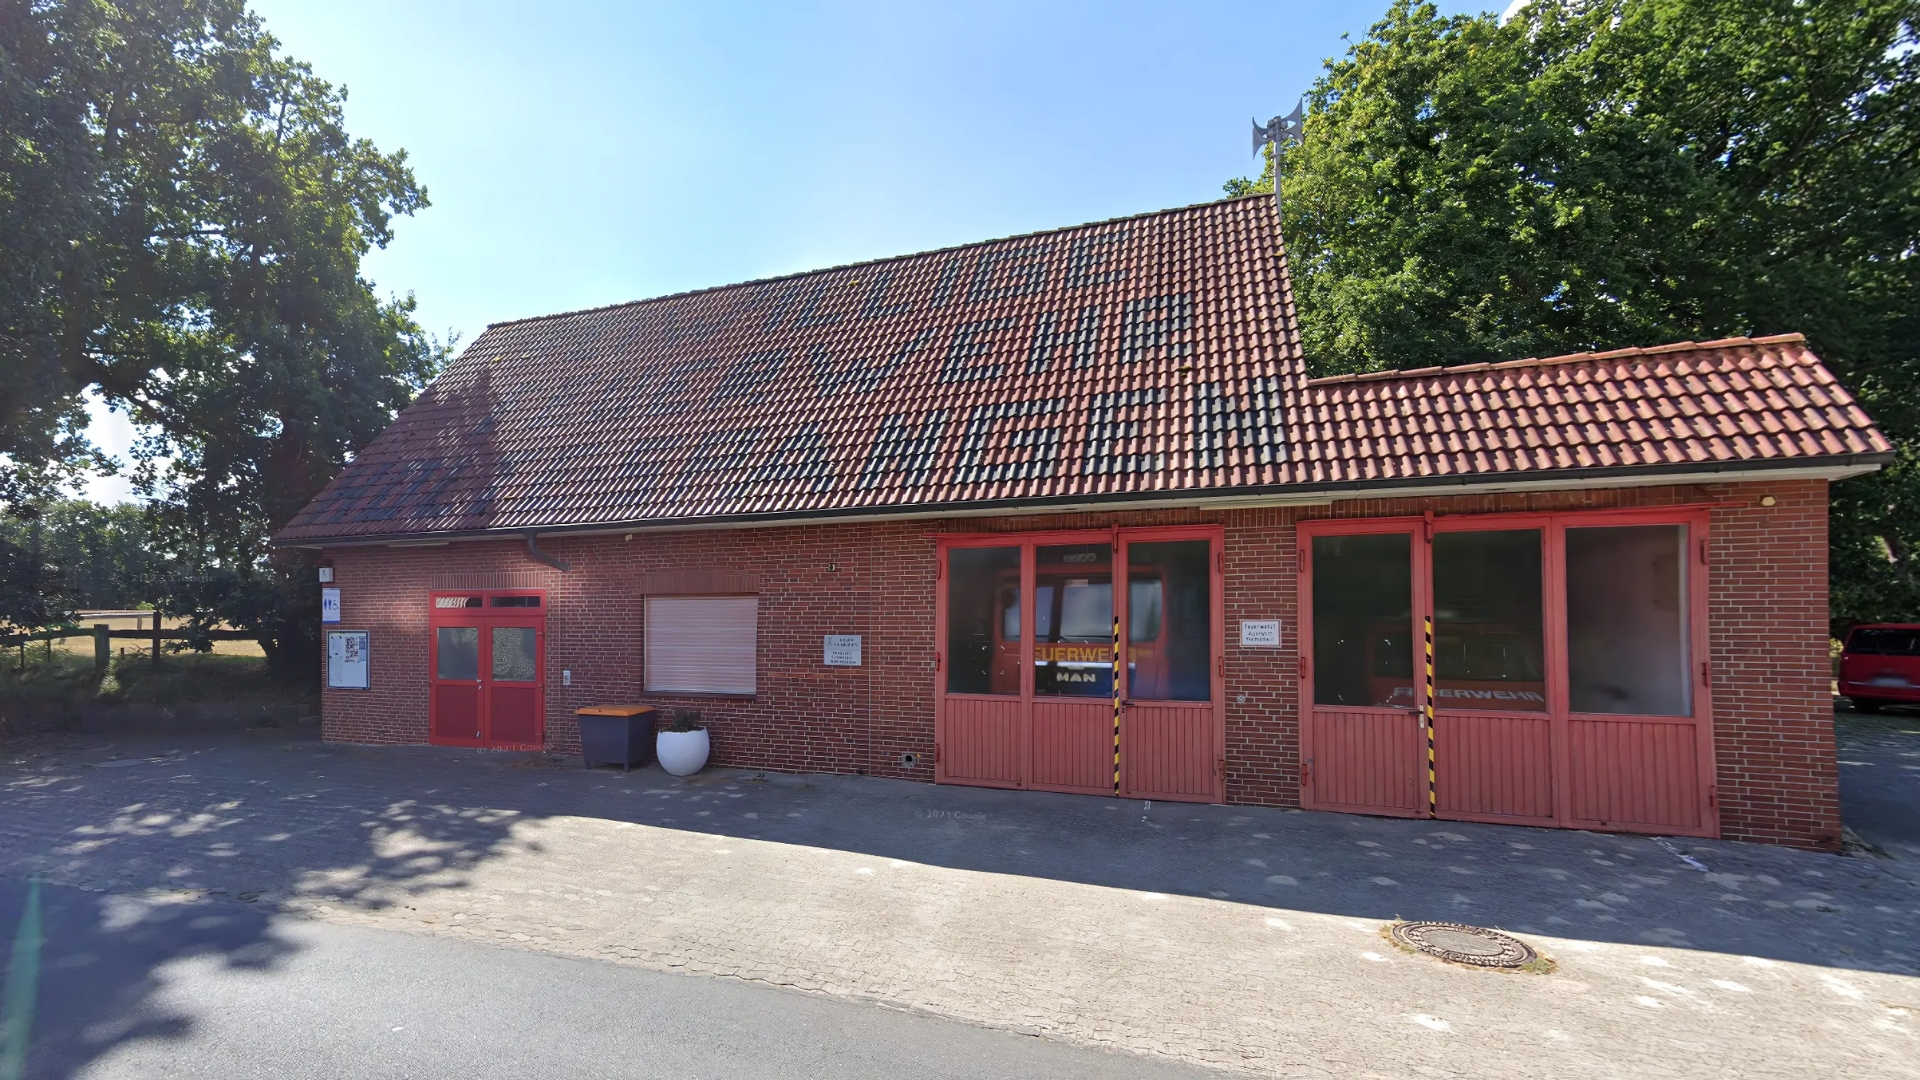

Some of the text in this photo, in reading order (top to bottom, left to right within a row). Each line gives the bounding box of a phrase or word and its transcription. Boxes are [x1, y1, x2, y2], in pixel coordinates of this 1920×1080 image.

[473, 294, 1198, 433] FEUERWEHR
[1056, 672, 1096, 682] MAN
[1393, 686, 1545, 702] FERWEHR
